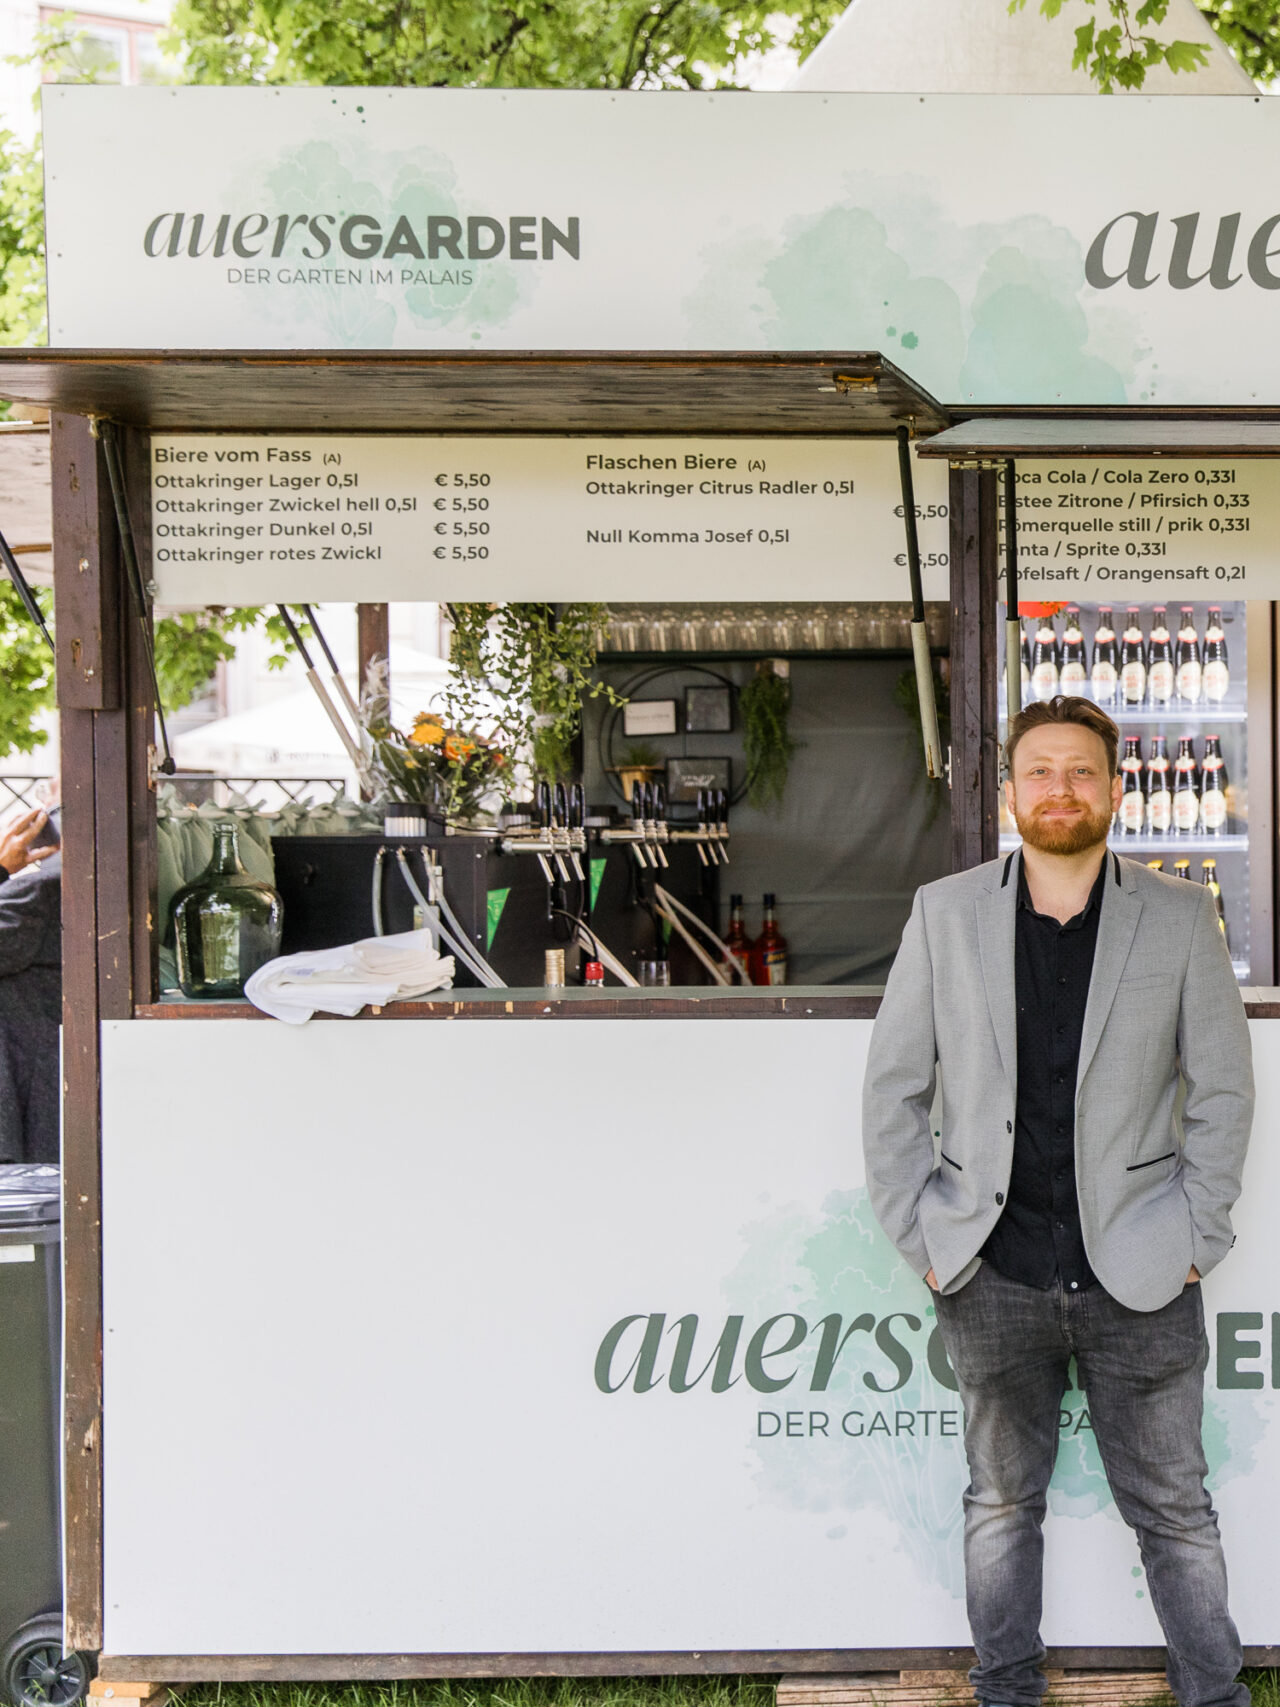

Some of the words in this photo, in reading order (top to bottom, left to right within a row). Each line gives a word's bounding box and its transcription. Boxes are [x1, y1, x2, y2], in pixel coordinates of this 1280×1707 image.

[144, 212, 580, 260] auersGARDEN
[228, 269, 270, 284] DER
[278, 269, 361, 284] GARTEN
[370, 270, 392, 284] IM
[402, 270, 472, 285] PALAIS
[155, 447, 208, 462] Biere
[215, 451, 259, 462] vom
[267, 448, 311, 462] Fass
[323, 453, 341, 465] (A)
[587, 455, 676, 469] Flaschen
[685, 454, 737, 469] Biere
[748, 460, 765, 472] (A)
[155, 474, 263, 490] Ottakringer
[270, 475, 321, 490] Lager
[327, 473, 358, 489] 0,5l
[435, 474, 447, 486] €
[454, 474, 490, 488] 5,50
[1048, 470, 1086, 483] Cola
[1091, 468, 1099, 485] /
[1104, 470, 1142, 483] Cola
[1149, 471, 1189, 483] Zero
[1195, 470, 1235, 485] 0,33l
[586, 480, 694, 497] Ottakringer
[700, 480, 753, 494] Citrus
[760, 481, 817, 494] Radler
[823, 480, 854, 496] 0,5l
[156, 498, 263, 515] Ottakringer
[270, 497, 340, 511] Zwickel
[347, 498, 379, 511] hell
[386, 498, 416, 513] 0,5l
[433, 498, 446, 511] €
[453, 498, 489, 512] 5,50
[998, 495, 1052, 508] Estee
[1058, 493, 1123, 507] Zitrone
[1128, 492, 1135, 509] /
[1141, 493, 1207, 507] Pfirsich
[1214, 494, 1249, 509] 0,33
[893, 505, 904, 518] €
[156, 523, 263, 539] Ottakringer
[270, 522, 334, 536] Dunkel
[341, 522, 372, 537] 0,5l
[434, 522, 447, 535] €
[453, 522, 489, 536] 5,50
[1119, 518, 1150, 531] still
[1156, 516, 1163, 533] /
[1169, 517, 1203, 534] prik
[1209, 518, 1249, 533] 0,33l
[587, 530, 621, 542] Null
[629, 530, 699, 542] Komma
[705, 529, 753, 542] Josef
[759, 529, 789, 544] 0,5l
[157, 547, 263, 564] Ottakringer
[270, 548, 315, 560] rotes
[322, 546, 381, 559] Zwickl
[433, 547, 446, 559] €
[452, 547, 489, 561] 5,50
[998, 543, 1049, 556] Fnta
[1054, 541, 1061, 557] /
[1067, 542, 1119, 559] Sprite
[1125, 542, 1166, 558] 0,33l
[894, 553, 907, 566] €
[918, 553, 949, 568] ,50
[1084, 565, 1092, 581] /
[1097, 566, 1209, 583] Orangensaft
[1215, 566, 1245, 581] 0,2l
[758, 1411, 829, 1437] DER
[842, 1409, 967, 1438] GARTE
